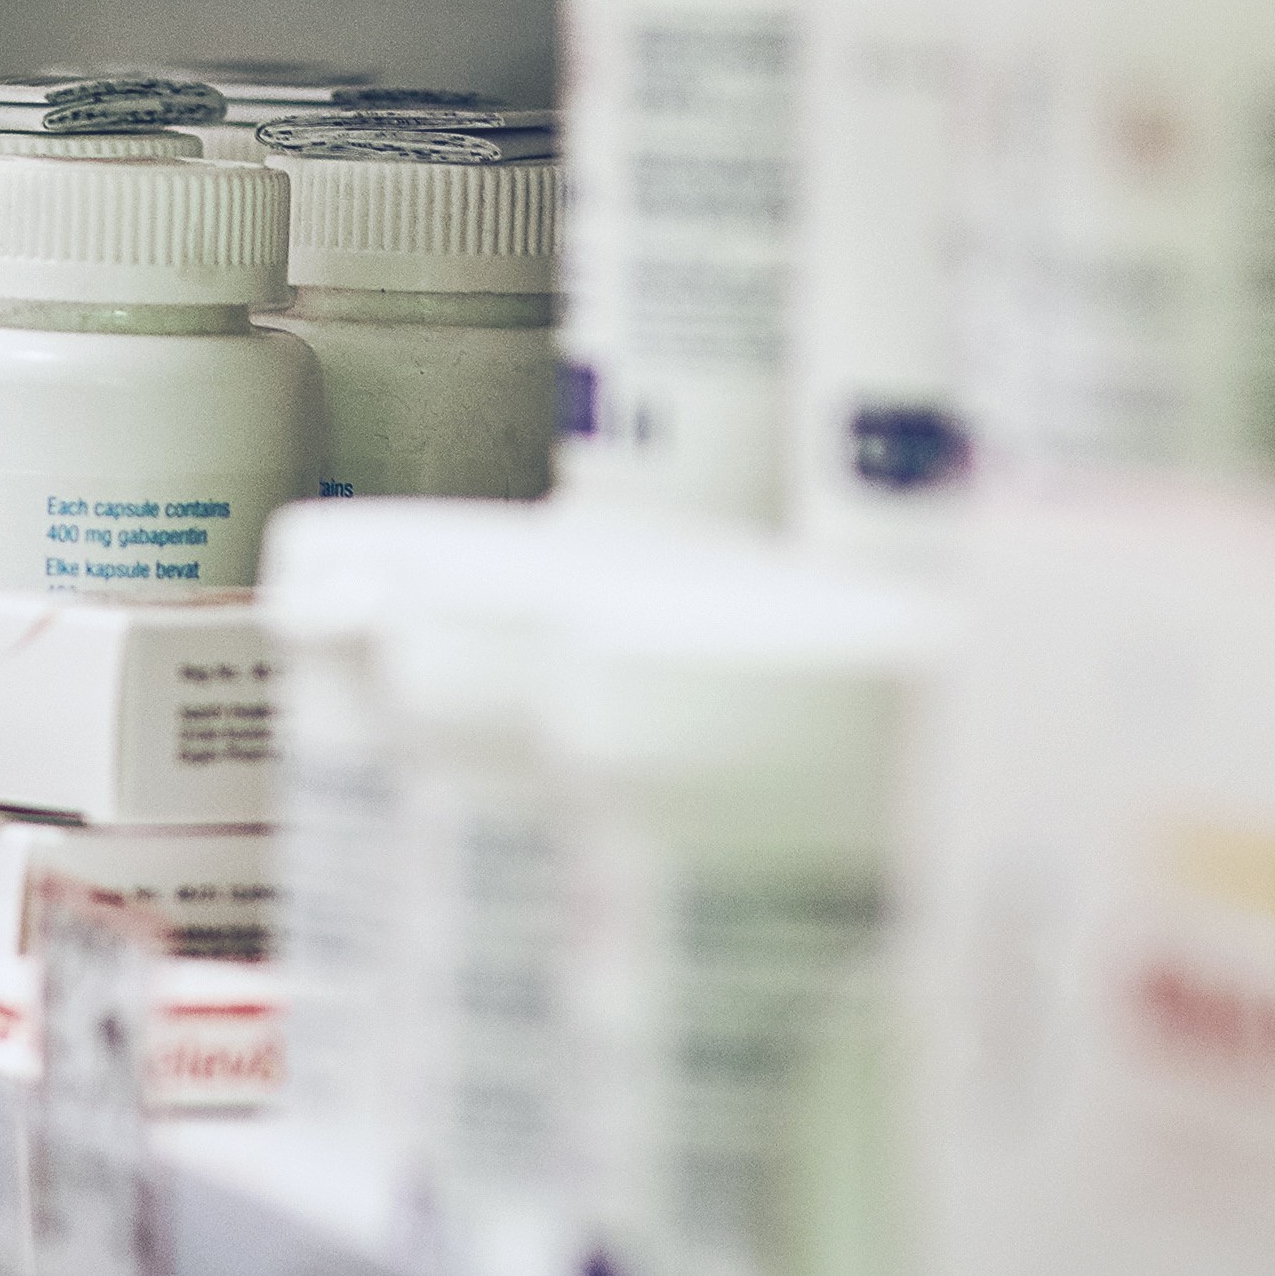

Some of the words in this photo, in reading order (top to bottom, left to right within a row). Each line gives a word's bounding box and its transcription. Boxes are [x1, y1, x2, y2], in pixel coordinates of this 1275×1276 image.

[47, 496, 88, 516] Each
[94, 499, 159, 520] capsule
[165, 498, 230, 518] contains
[47, 523, 79, 543] 400
[86, 529, 111, 547] mg
[118, 526, 208, 548] gabapentin
[46, 557, 79, 577] Elke
[86, 560, 149, 580] kapsule
[156, 560, 200, 579] bevat
